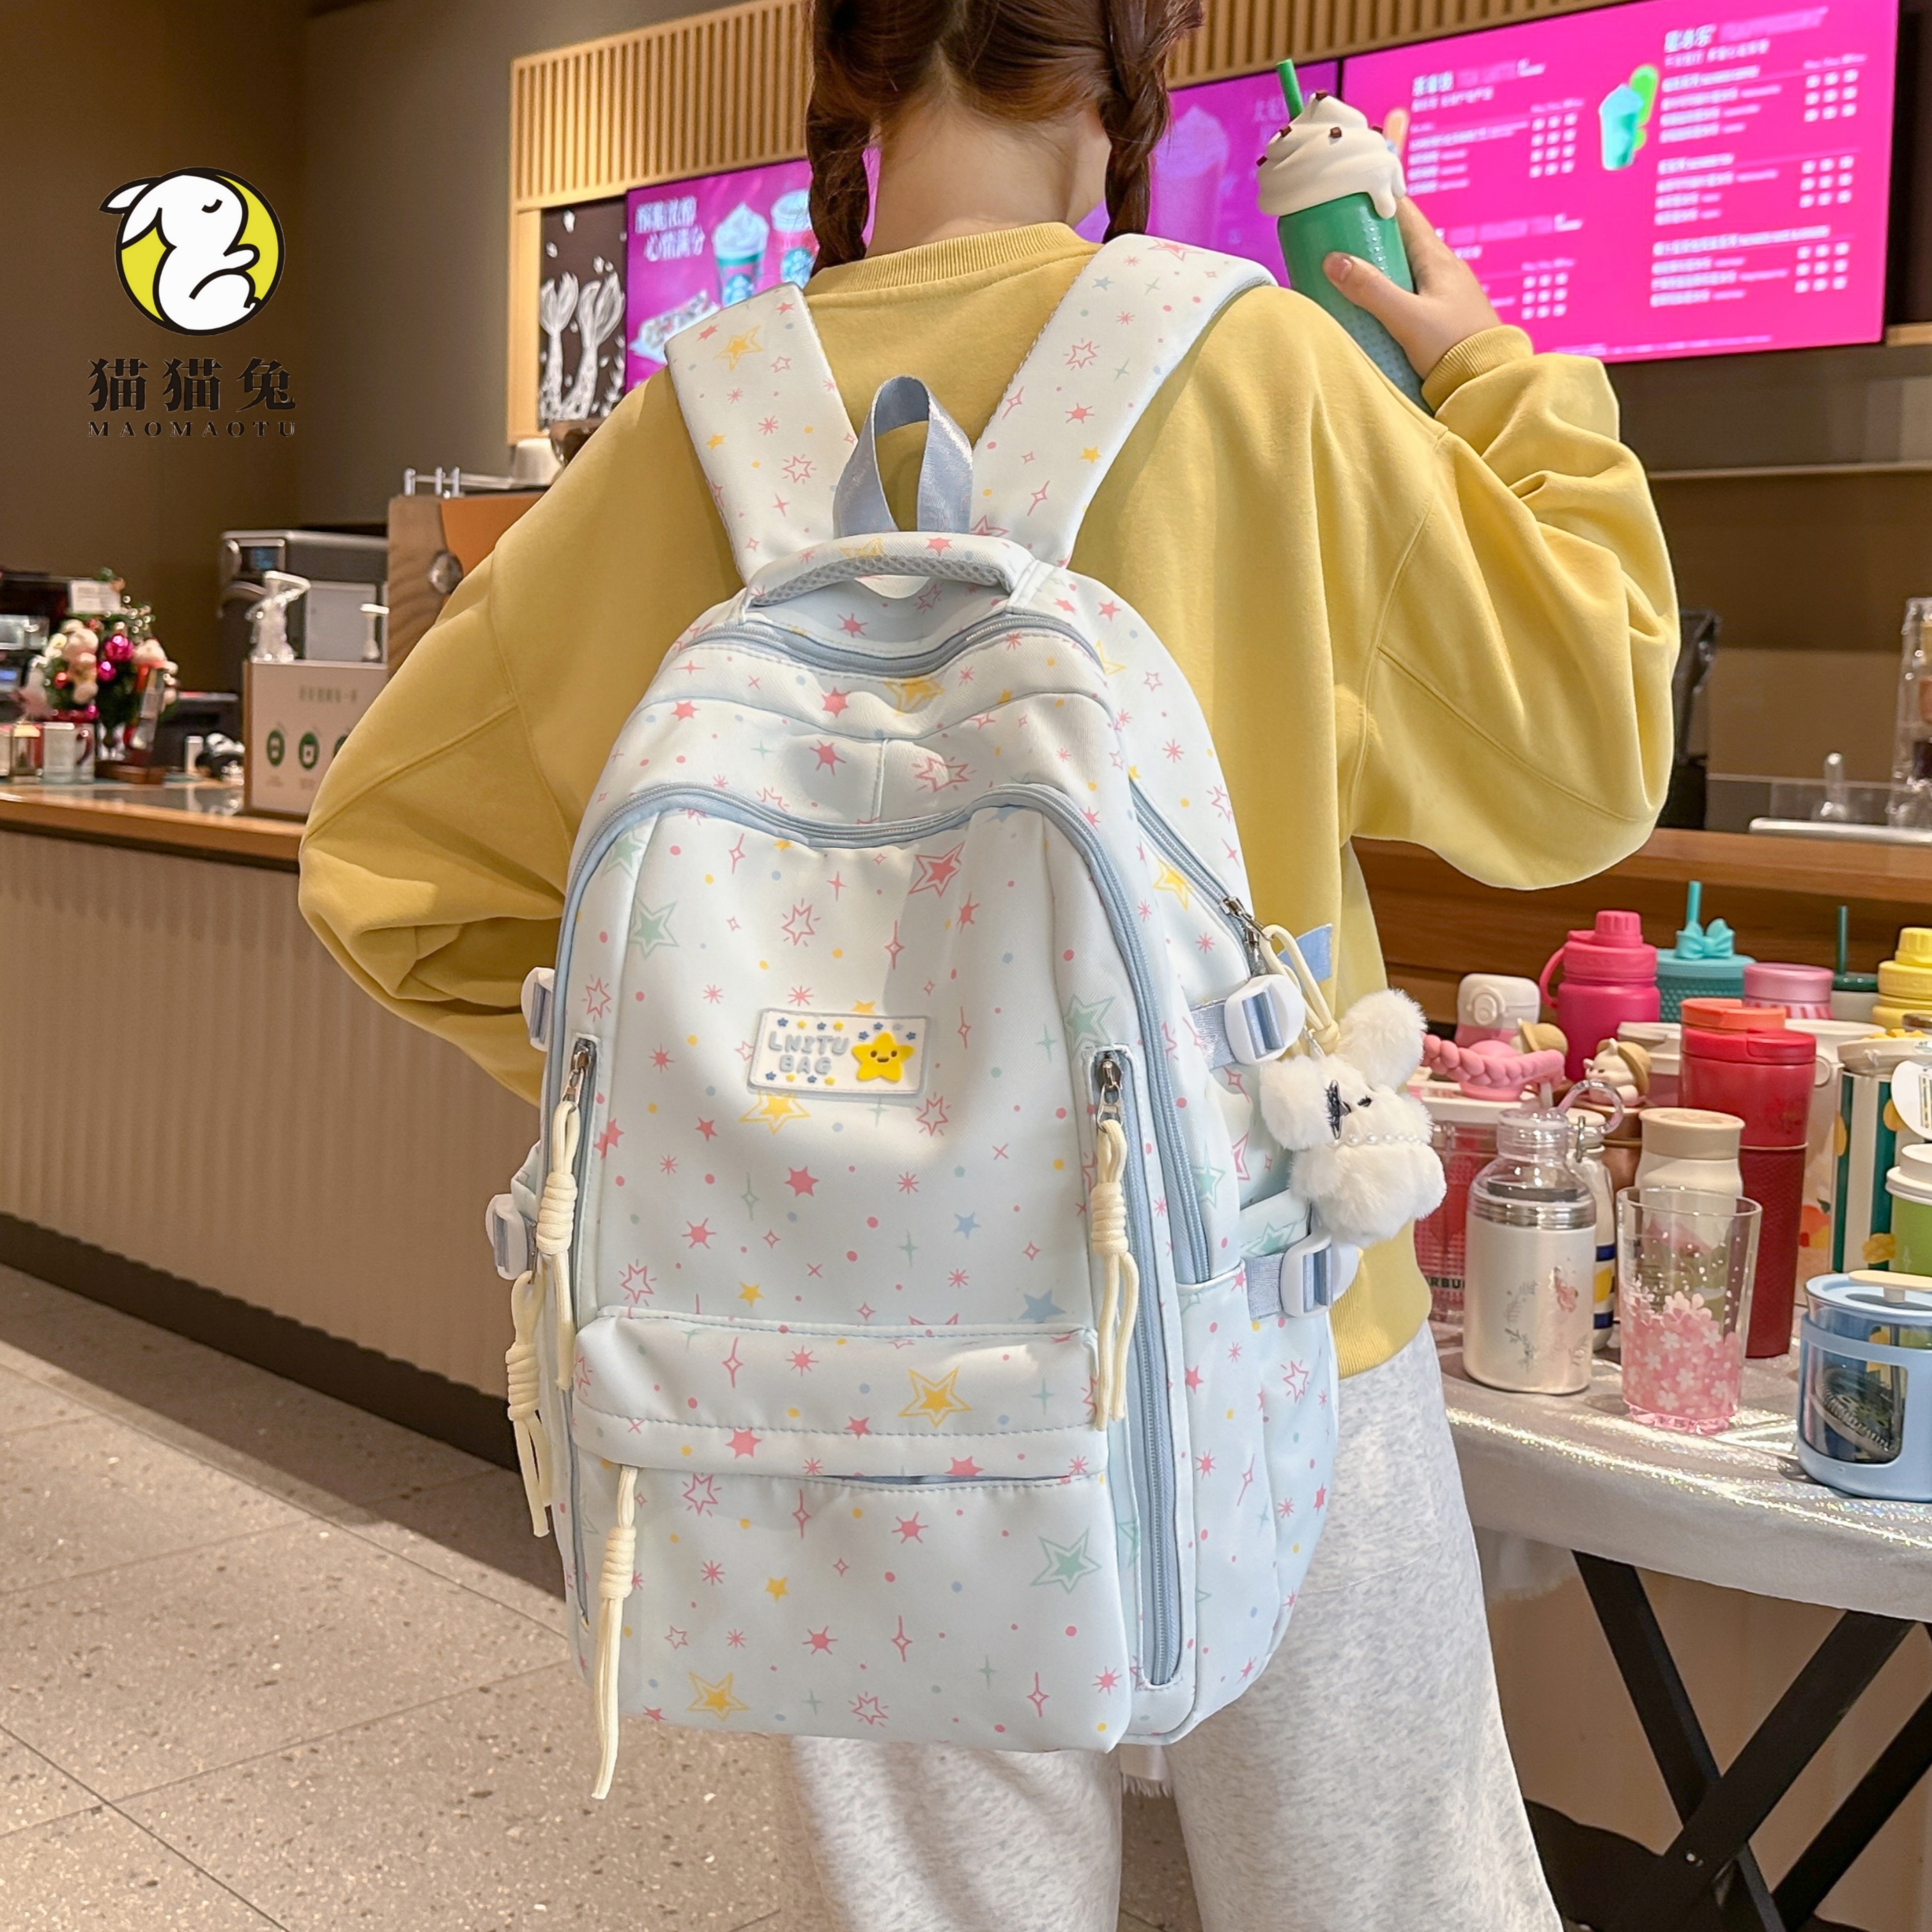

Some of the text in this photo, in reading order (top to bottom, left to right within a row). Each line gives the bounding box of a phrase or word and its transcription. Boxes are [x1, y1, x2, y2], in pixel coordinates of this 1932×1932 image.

[769, 1031, 850, 1055] LNITU
[779, 1054, 832, 1075] BAG
[1425, 1276, 1465, 1289] RBU
